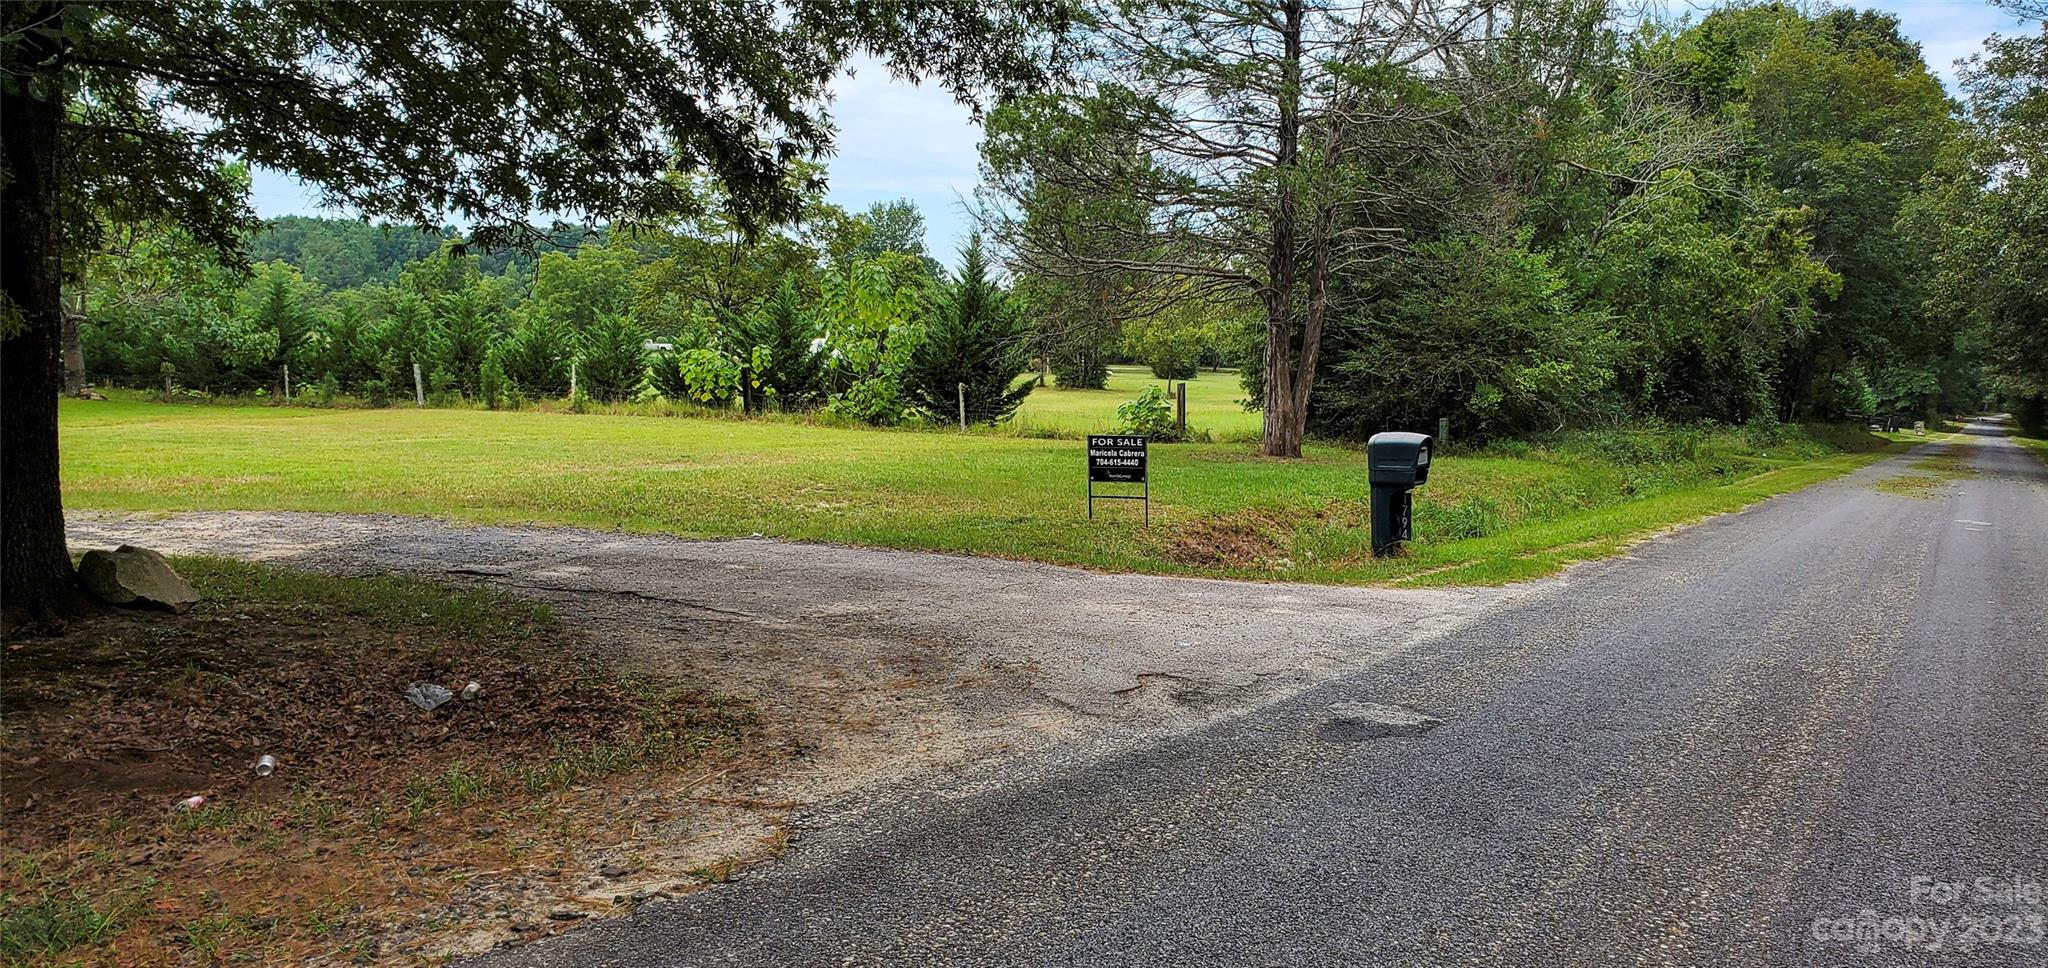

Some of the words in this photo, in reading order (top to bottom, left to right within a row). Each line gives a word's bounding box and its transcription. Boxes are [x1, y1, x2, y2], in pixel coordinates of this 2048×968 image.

[1092, 438, 1114, 446] FOR
[1117, 438, 1143, 446] SALE
[1090, 449, 1117, 457] Maricela
[1119, 449, 1144, 457] Cabrera
[1095, 458, 1139, 466] 704-615-4440
